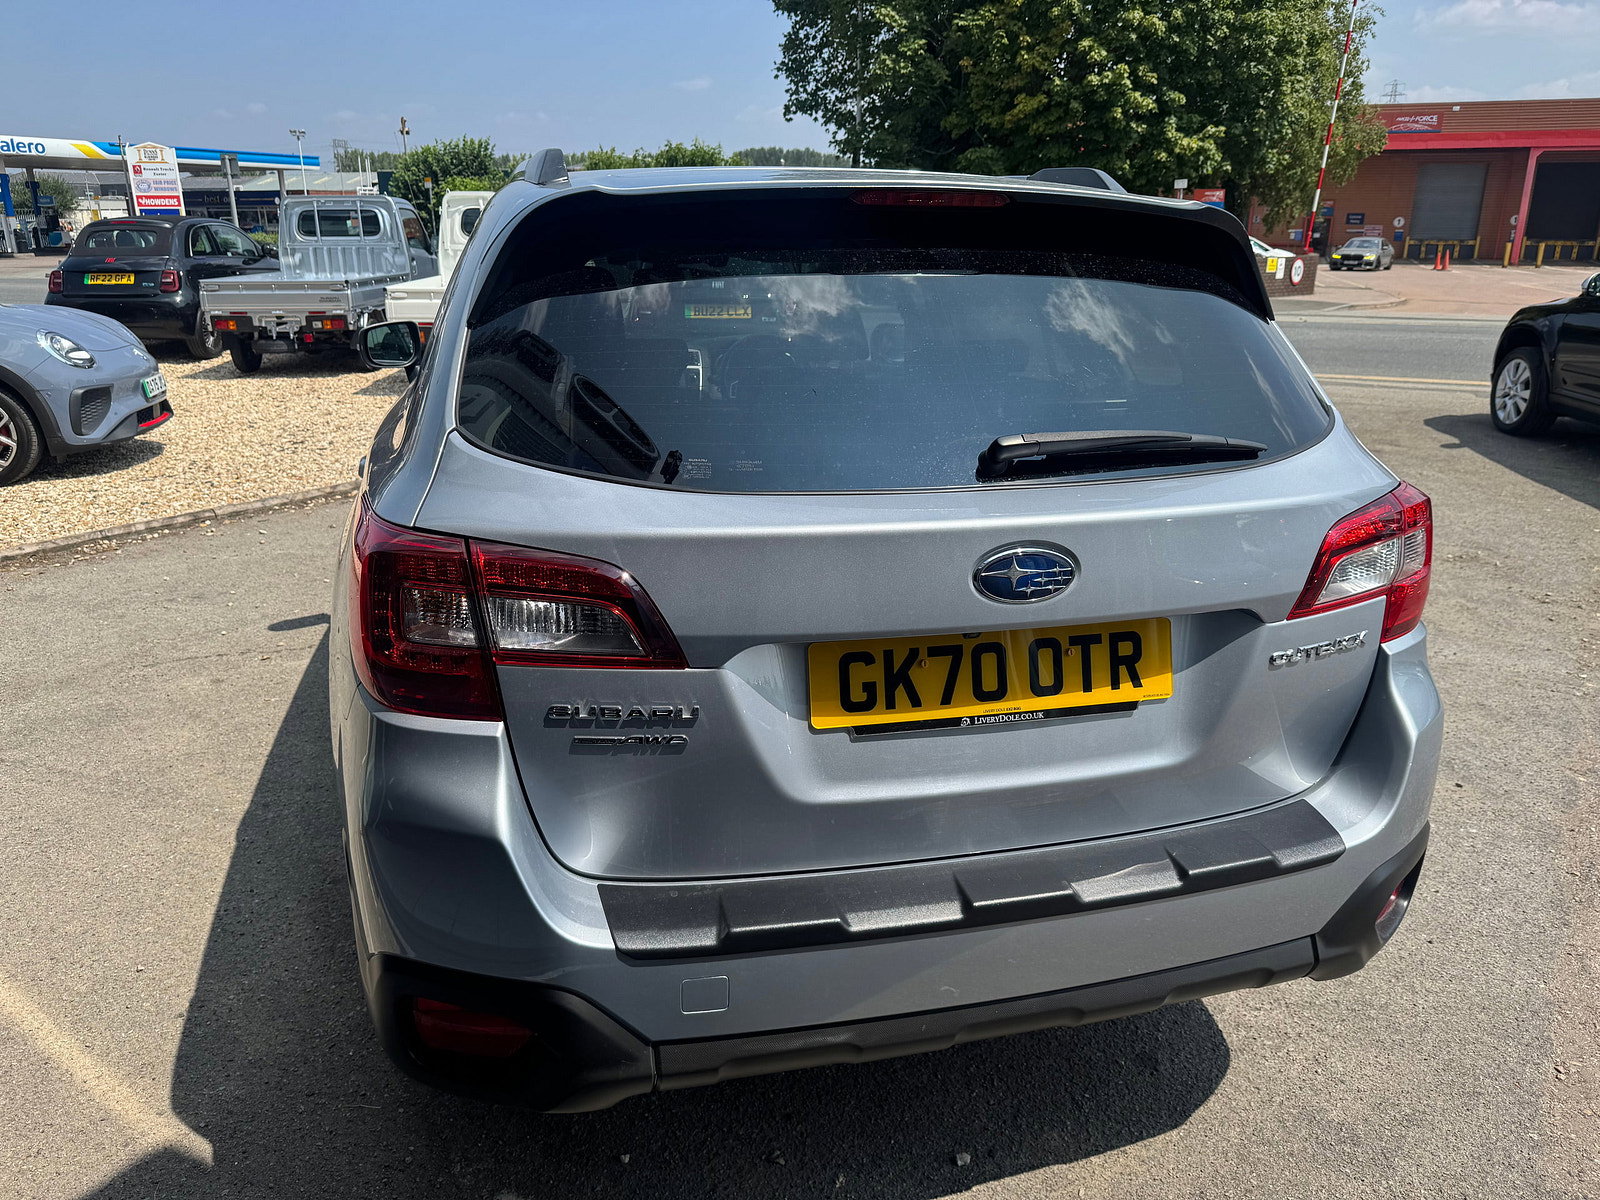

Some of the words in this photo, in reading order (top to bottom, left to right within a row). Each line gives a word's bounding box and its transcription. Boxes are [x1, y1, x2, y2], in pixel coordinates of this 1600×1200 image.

[145, 198, 179, 206] HOWDENS
[90, 274, 113, 282] RF22
[114, 274, 132, 282] GFA
[837, 641, 1007, 713] GK70
[1028, 630, 1144, 697] OTR
[546, 703, 700, 721] SUBARU
